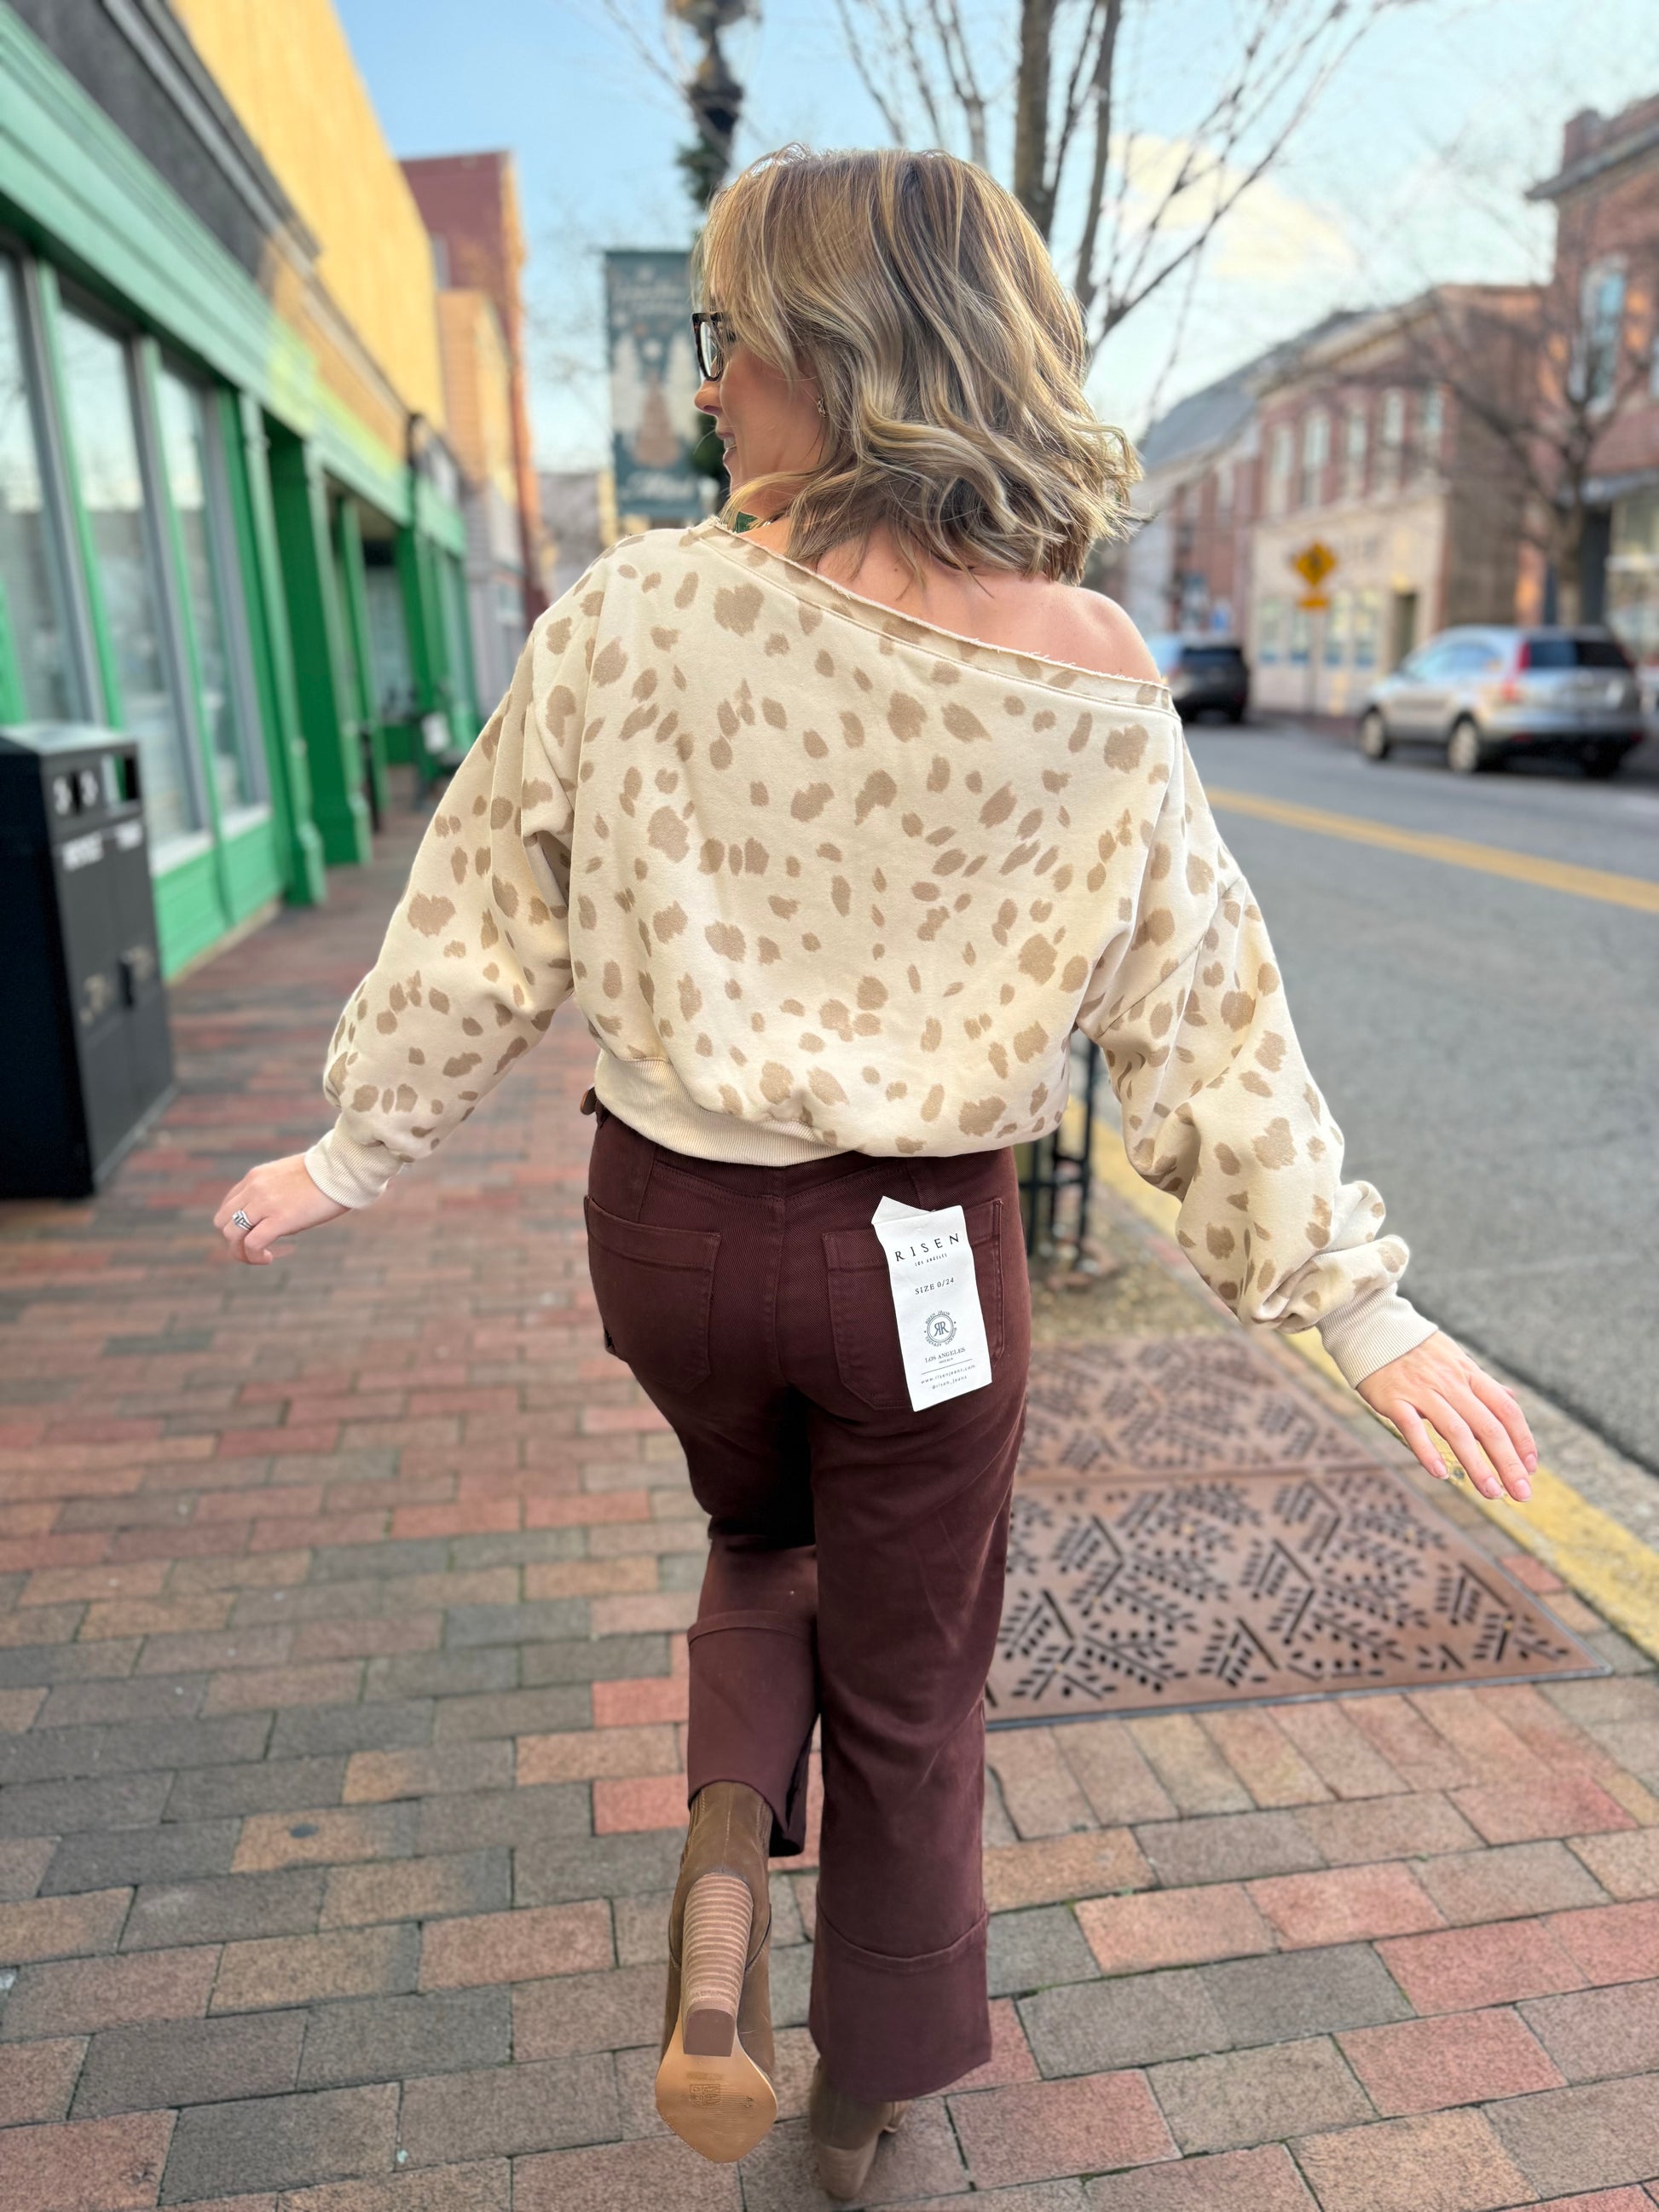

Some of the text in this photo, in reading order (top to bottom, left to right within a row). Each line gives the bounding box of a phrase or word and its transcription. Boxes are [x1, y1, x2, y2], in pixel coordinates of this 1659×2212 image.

[894, 1233, 959, 1262] RISEN
[915, 1277, 954, 1295] SIZE 0/24
[938, 1347, 966, 1360] ANGELES
[921, 1365, 975, 1384] www.risenjeans.com
[932, 1376, 967, 1389] @risen_jeans
